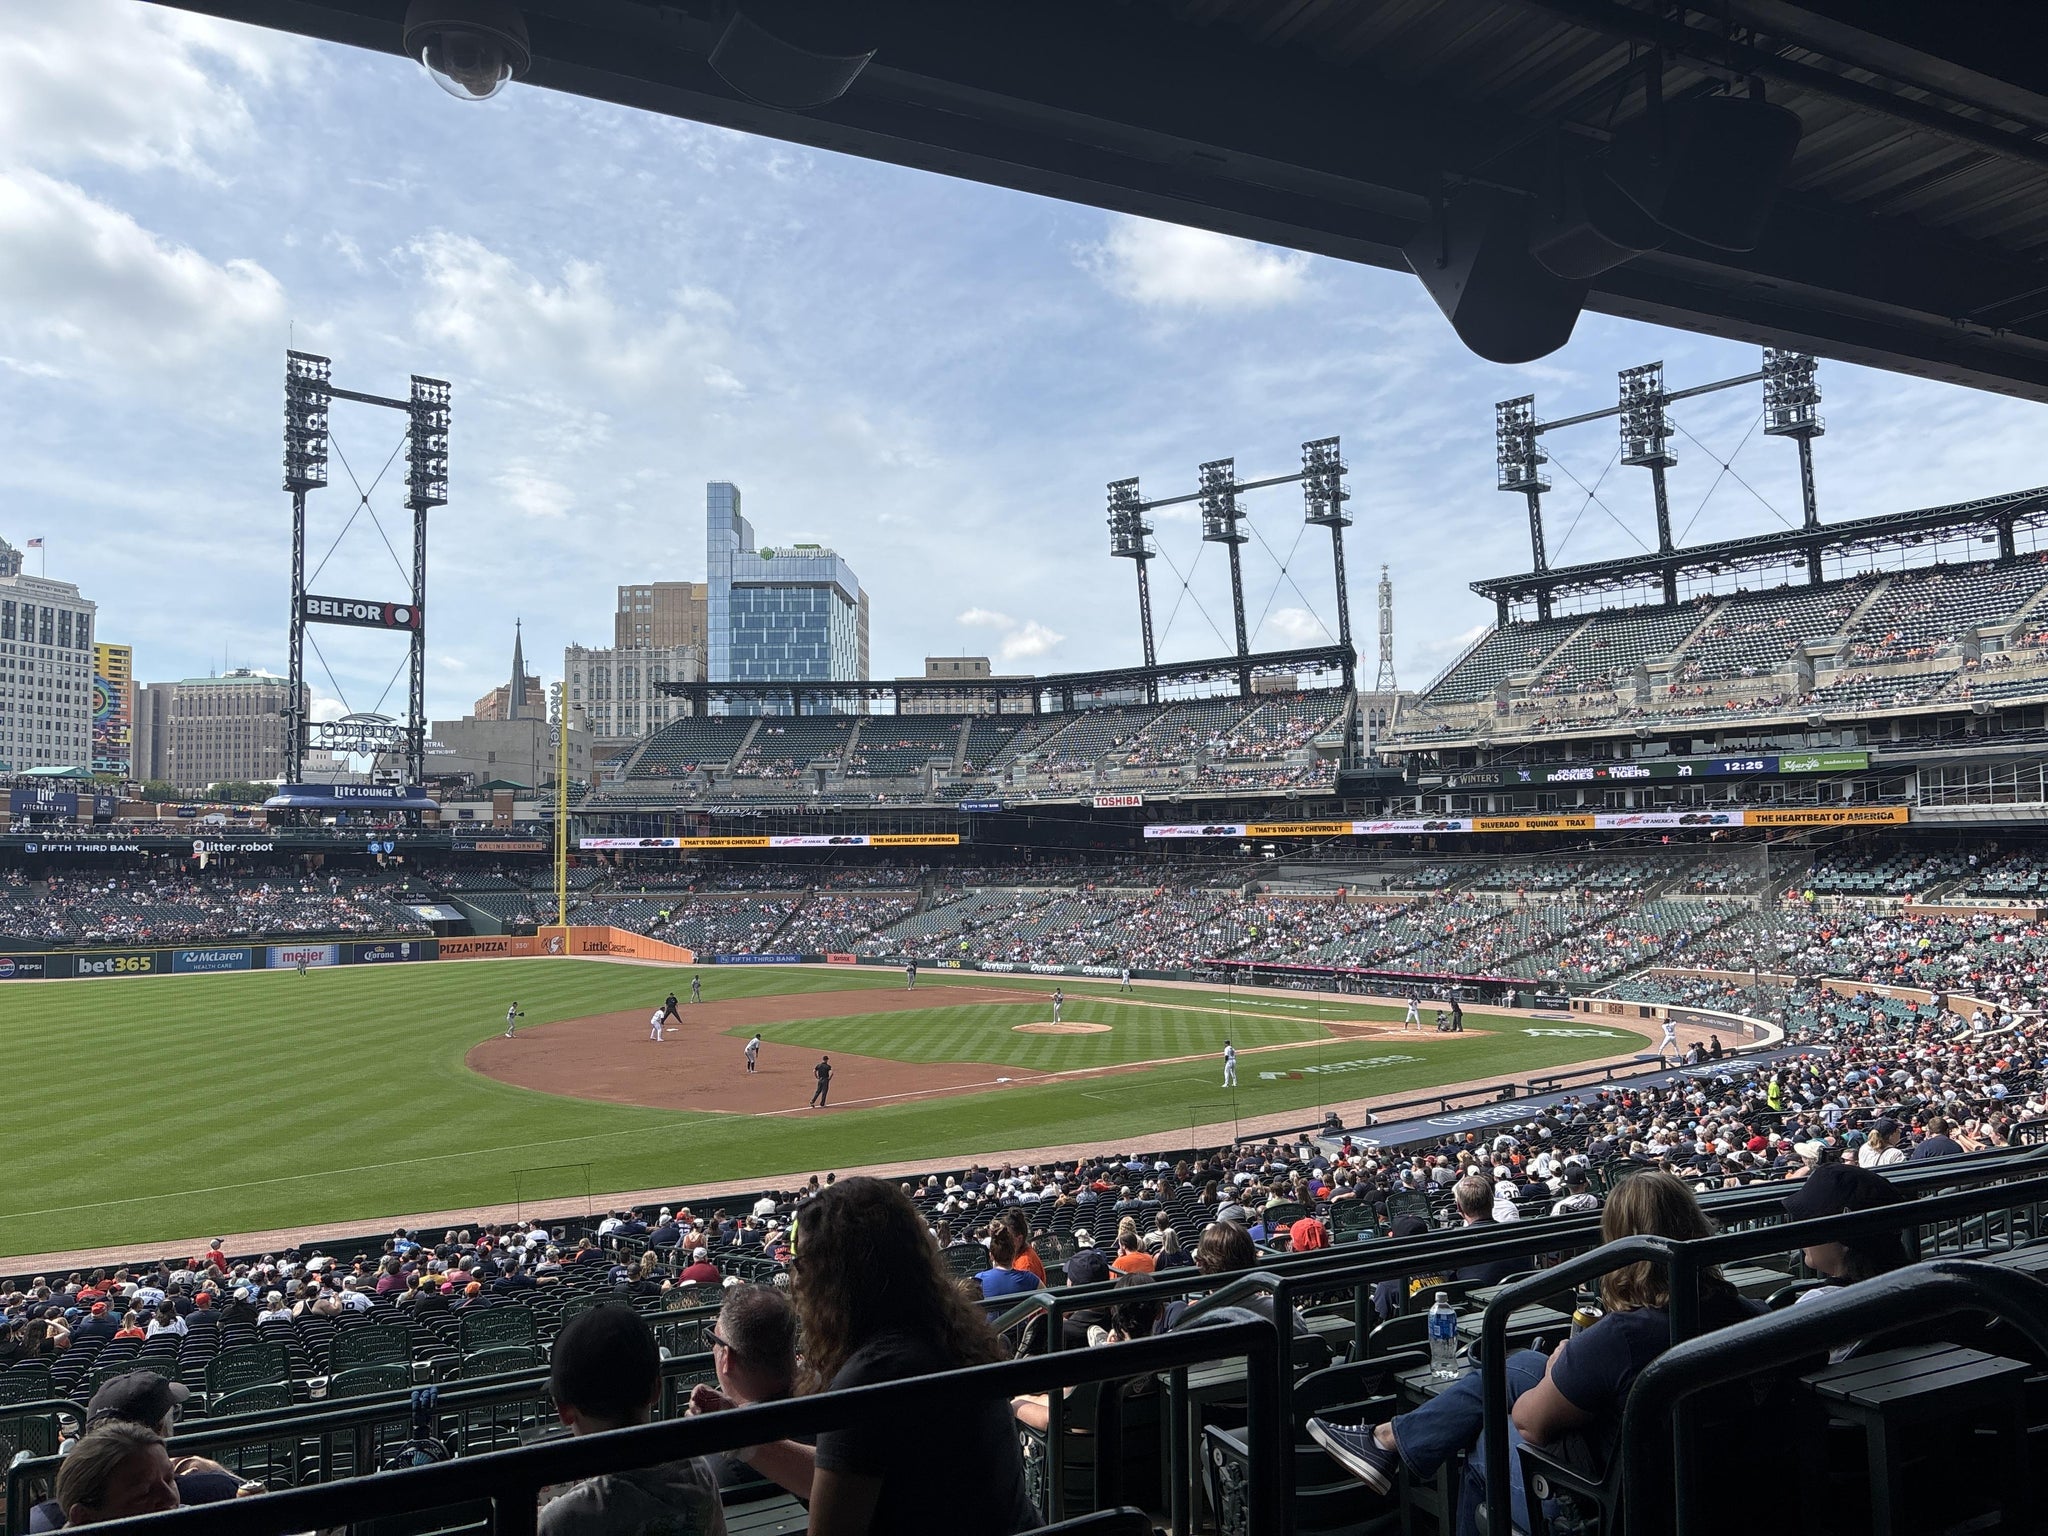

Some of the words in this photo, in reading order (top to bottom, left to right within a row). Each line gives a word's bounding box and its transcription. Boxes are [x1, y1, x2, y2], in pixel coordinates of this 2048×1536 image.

[774, 547, 832, 560] Huntington
[306, 599, 380, 620] BELFOR
[550, 695, 563, 747] Rocket
[1724, 761, 1764, 771] 12:25
[1547, 773, 1594, 782] ROCKIES
[1610, 769, 1650, 778] TIGERS
[1460, 774, 1500, 784] WINTER'S
[36, 788, 55, 804] Lite
[334, 786, 356, 798] Lite
[358, 788, 392, 796] LOUNGE
[1095, 796, 1140, 806] TOSHIBA
[22, 804, 54, 812] PITCHER'S
[55, 804, 67, 812] PUB
[771, 806, 797, 815] TIGER
[806, 806, 827, 815] CLUB
[1756, 814, 1773, 822] THE
[1776, 813, 1830, 822] HEARTBEAT
[1832, 812, 1846, 821] OF
[1847, 812, 1894, 820] AMERICA
[1526, 820, 1558, 828] EQUINOX
[42, 844, 72, 852] FIFTH
[76, 844, 107, 852] THIRD
[110, 844, 140, 852] BANK
[440, 944, 472, 954] PIZZA!
[475, 942, 508, 952] PIZZA!
[582, 941, 608, 952] Little
[200, 952, 244, 962] McLaren
[282, 949, 324, 964] meijer
[364, 951, 394, 961] Corona
[79, 956, 151, 973] bet365
[937, 960, 960, 968] bet365
[1702, 1018, 1736, 1028] CHEVROLET
[1536, 1480, 1544, 1492] D
